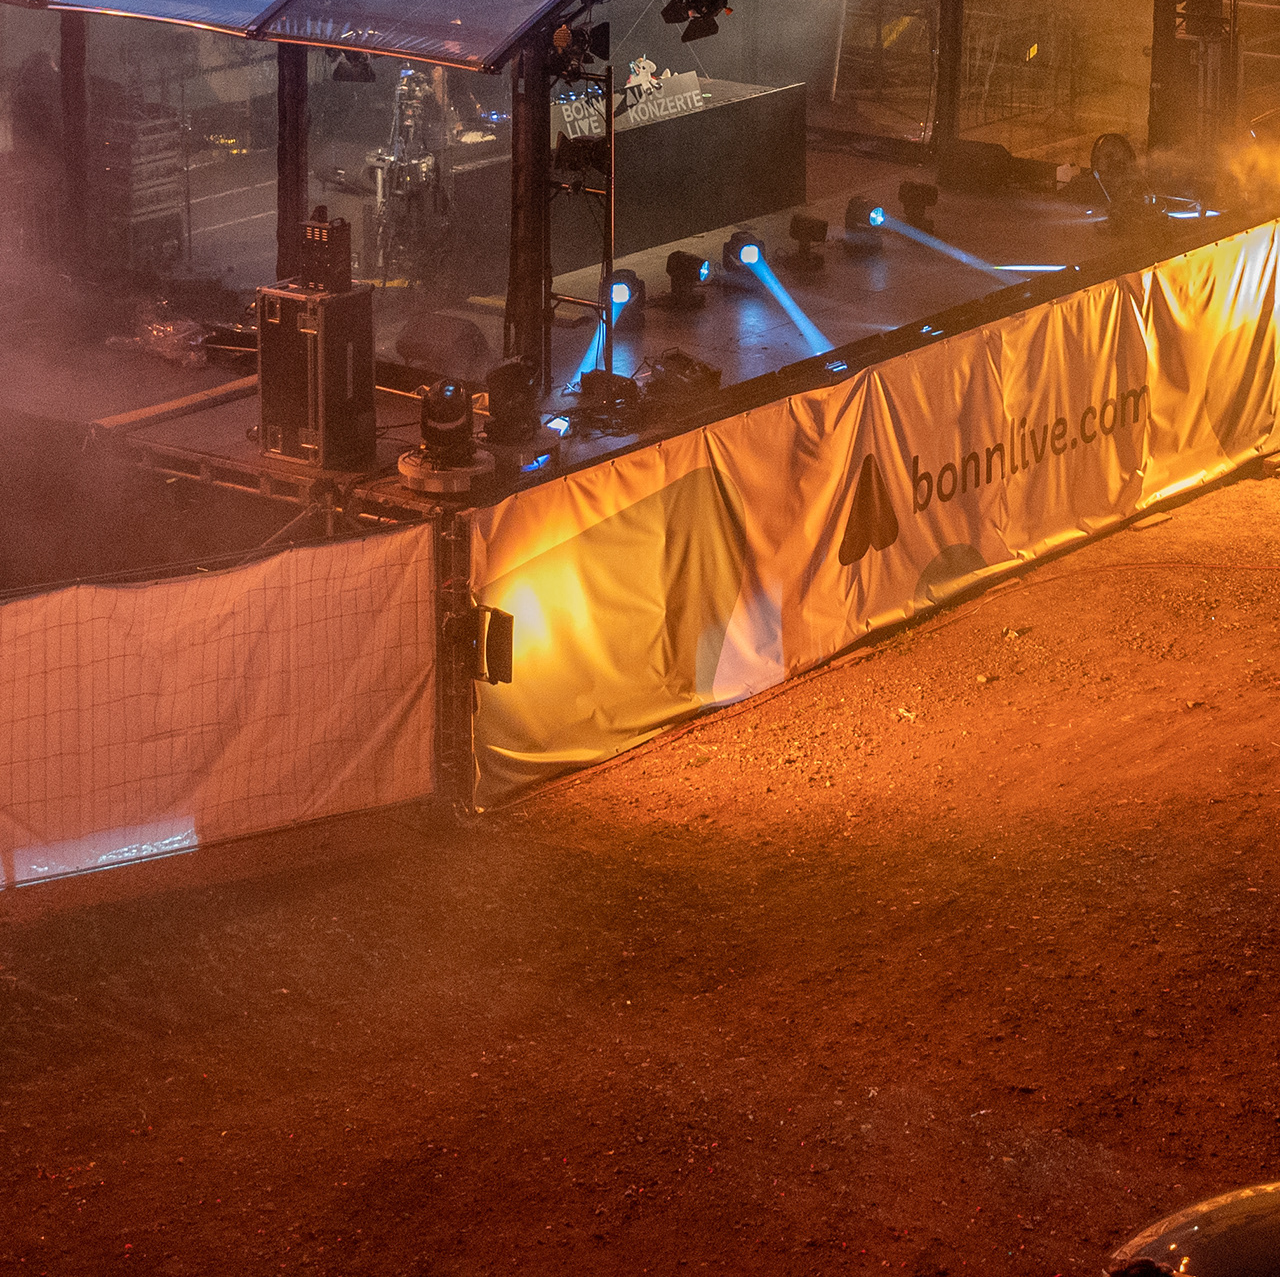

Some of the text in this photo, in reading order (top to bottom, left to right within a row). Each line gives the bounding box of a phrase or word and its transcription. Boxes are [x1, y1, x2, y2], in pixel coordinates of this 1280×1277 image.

[627, 89, 704, 124] KONZERTE
[566, 116, 602, 140] LIVE
[911, 382, 1149, 516] bonnlive.com
